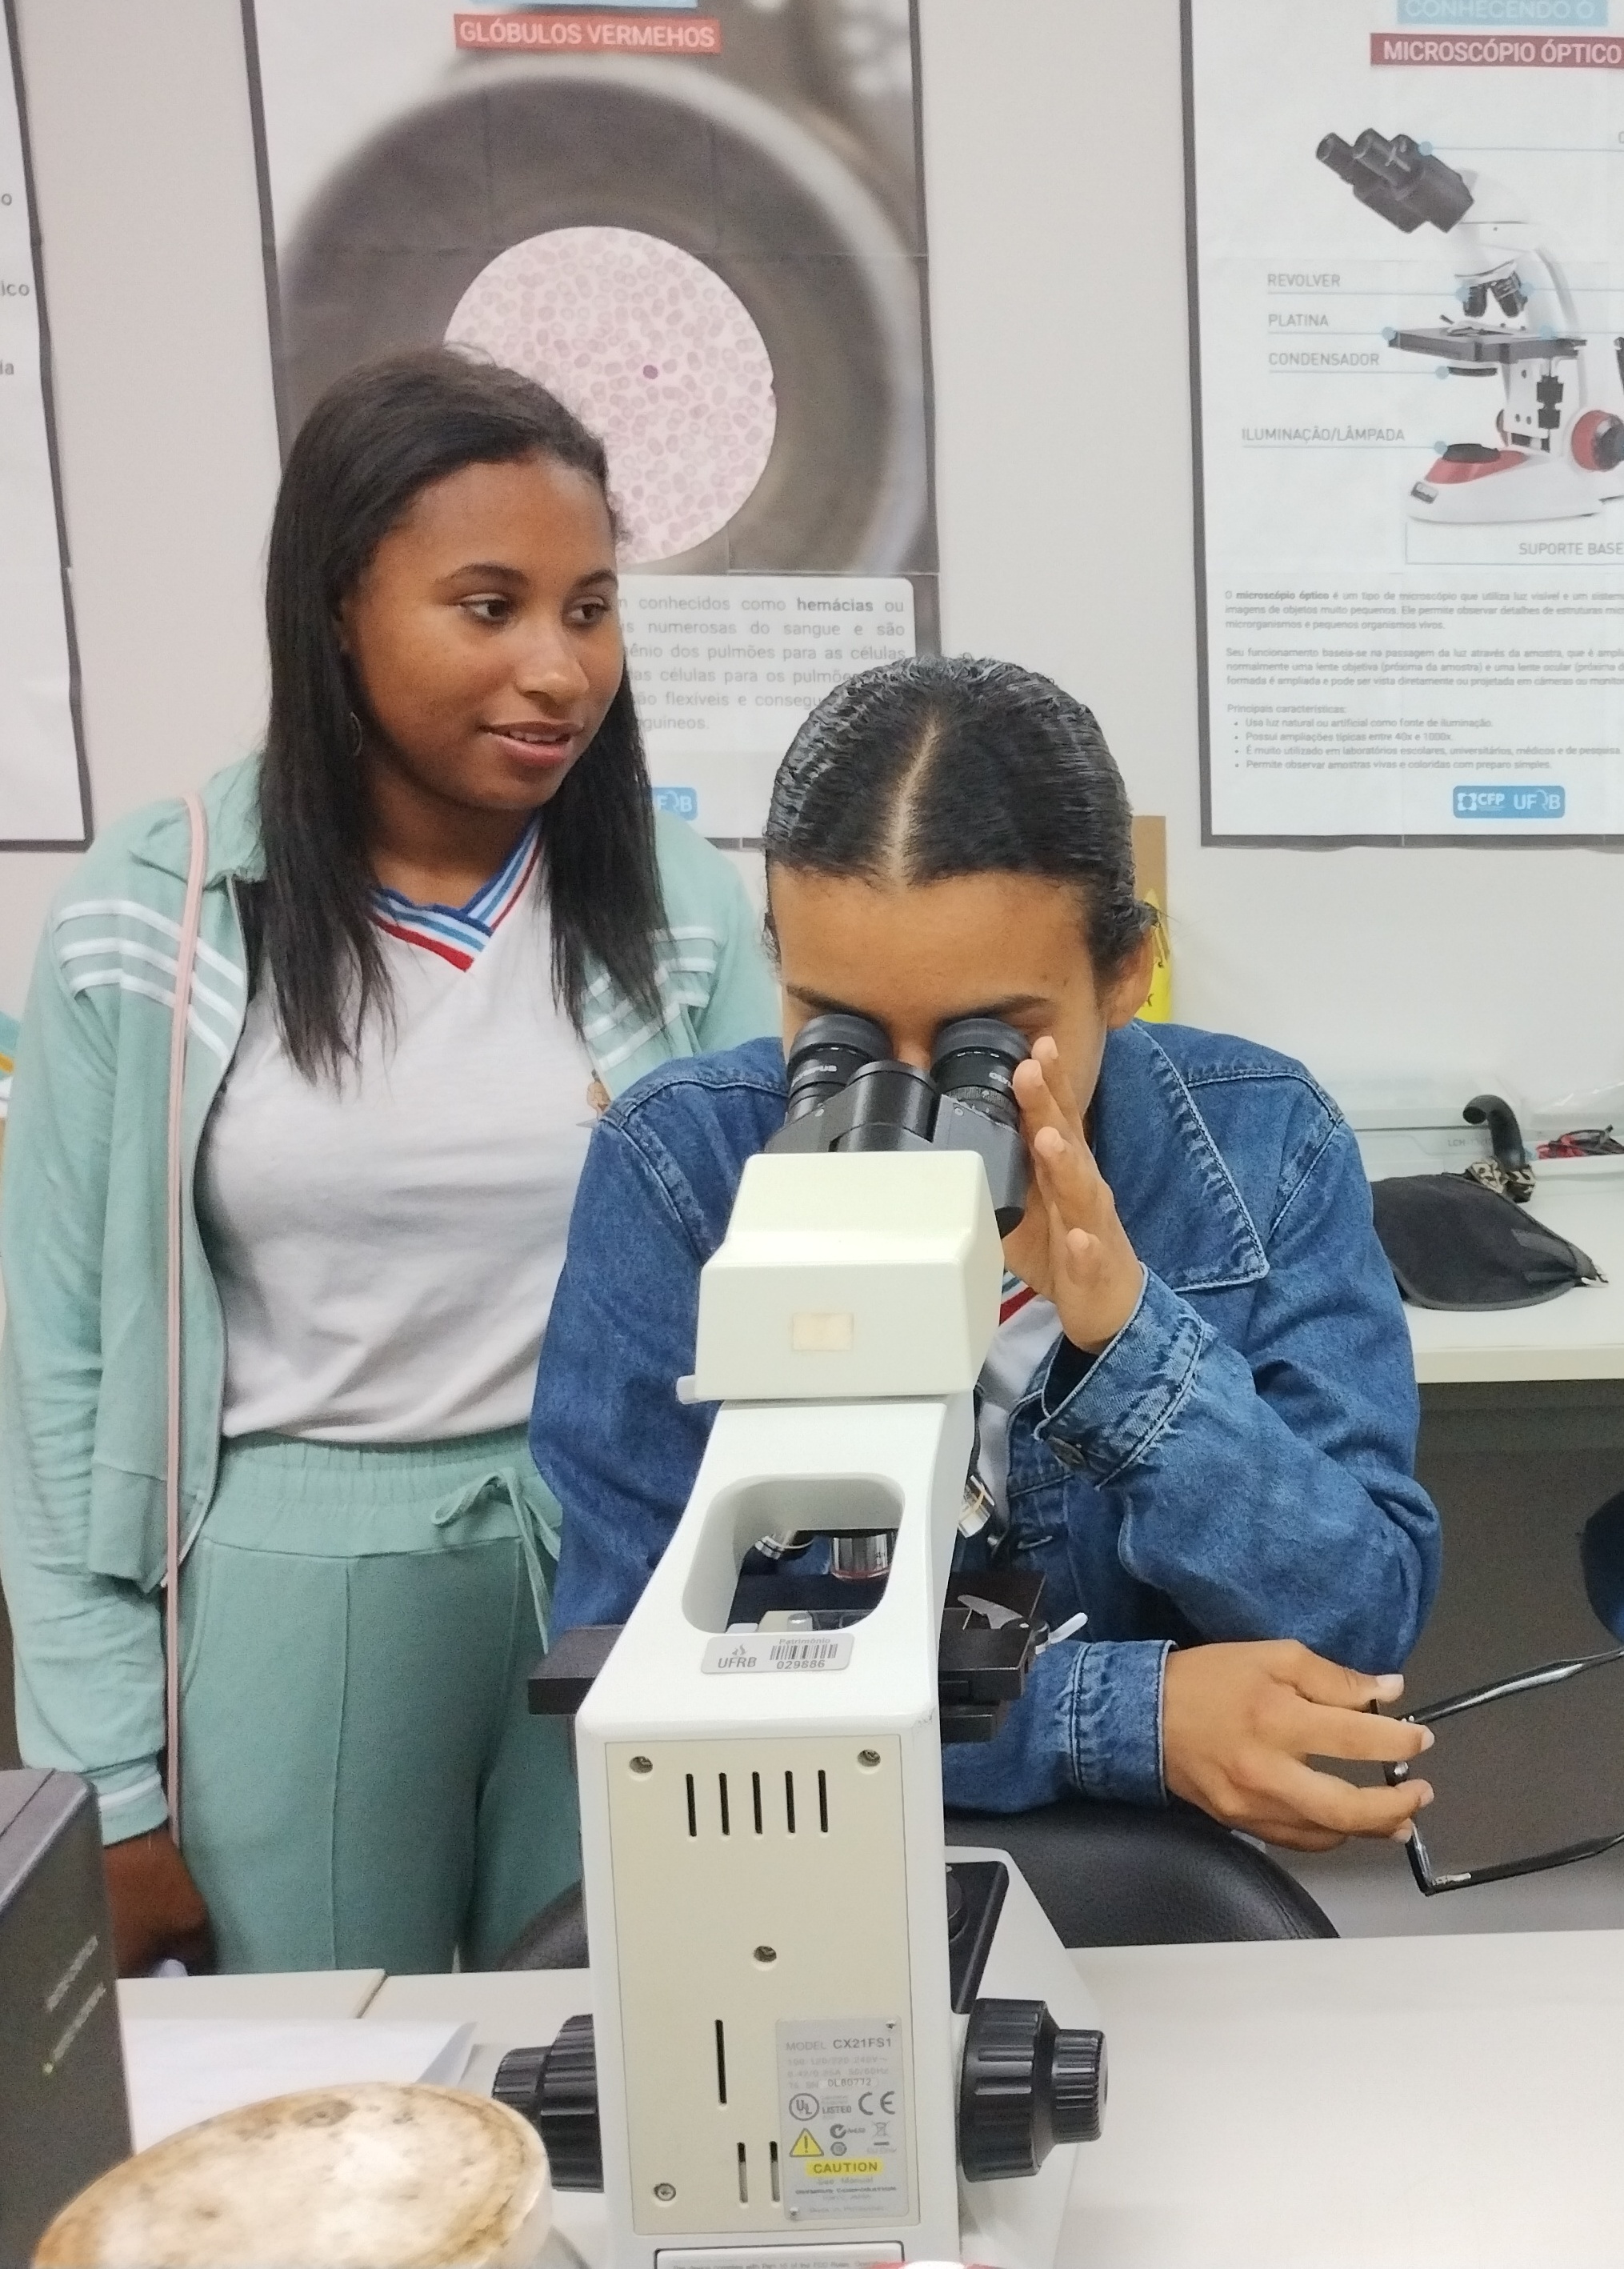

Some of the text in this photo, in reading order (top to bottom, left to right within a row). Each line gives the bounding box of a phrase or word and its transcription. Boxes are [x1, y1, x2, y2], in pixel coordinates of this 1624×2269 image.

[1406, 0, 1570, 18] CONHECENDO
[459, 18, 715, 47] GLÓBULOS VERMEHOS
[1383, 38, 1622, 64] MICROSCÓPIO ÓPTICO
[1267, 273, 1341, 288] REVOLVER
[1268, 313, 1329, 327] PLATINA
[1269, 352, 1380, 366] CONDENSADOR
[1242, 425, 1406, 444] ILUMINAÇÃO/LÂMPADA
[1518, 541, 1624, 555] SUPORTE BASE
[638, 595, 731, 611] conhecidos
[742, 600, 786, 611] como
[797, 597, 874, 612] hemácias
[885, 601, 904, 613] ou
[648, 620, 906, 639] numerosas do sangue e são
[670, 643, 700, 658] dos
[707, 644, 775, 661] pulmões
[782, 647, 817, 662] para
[825, 648, 843, 660] as
[850, 645, 906, 661] células
[659, 666, 858, 686] células para os pulmõe
[666, 690, 730, 706] flexíveis
[738, 695, 747, 706] e
[1478, 793, 1506, 806] CFP
[718, 1657, 826, 1670] UFRB 029886
[786, 2038, 892, 2051] MODEL CX21FS1
[813, 2161, 878, 2175] CAUTION
